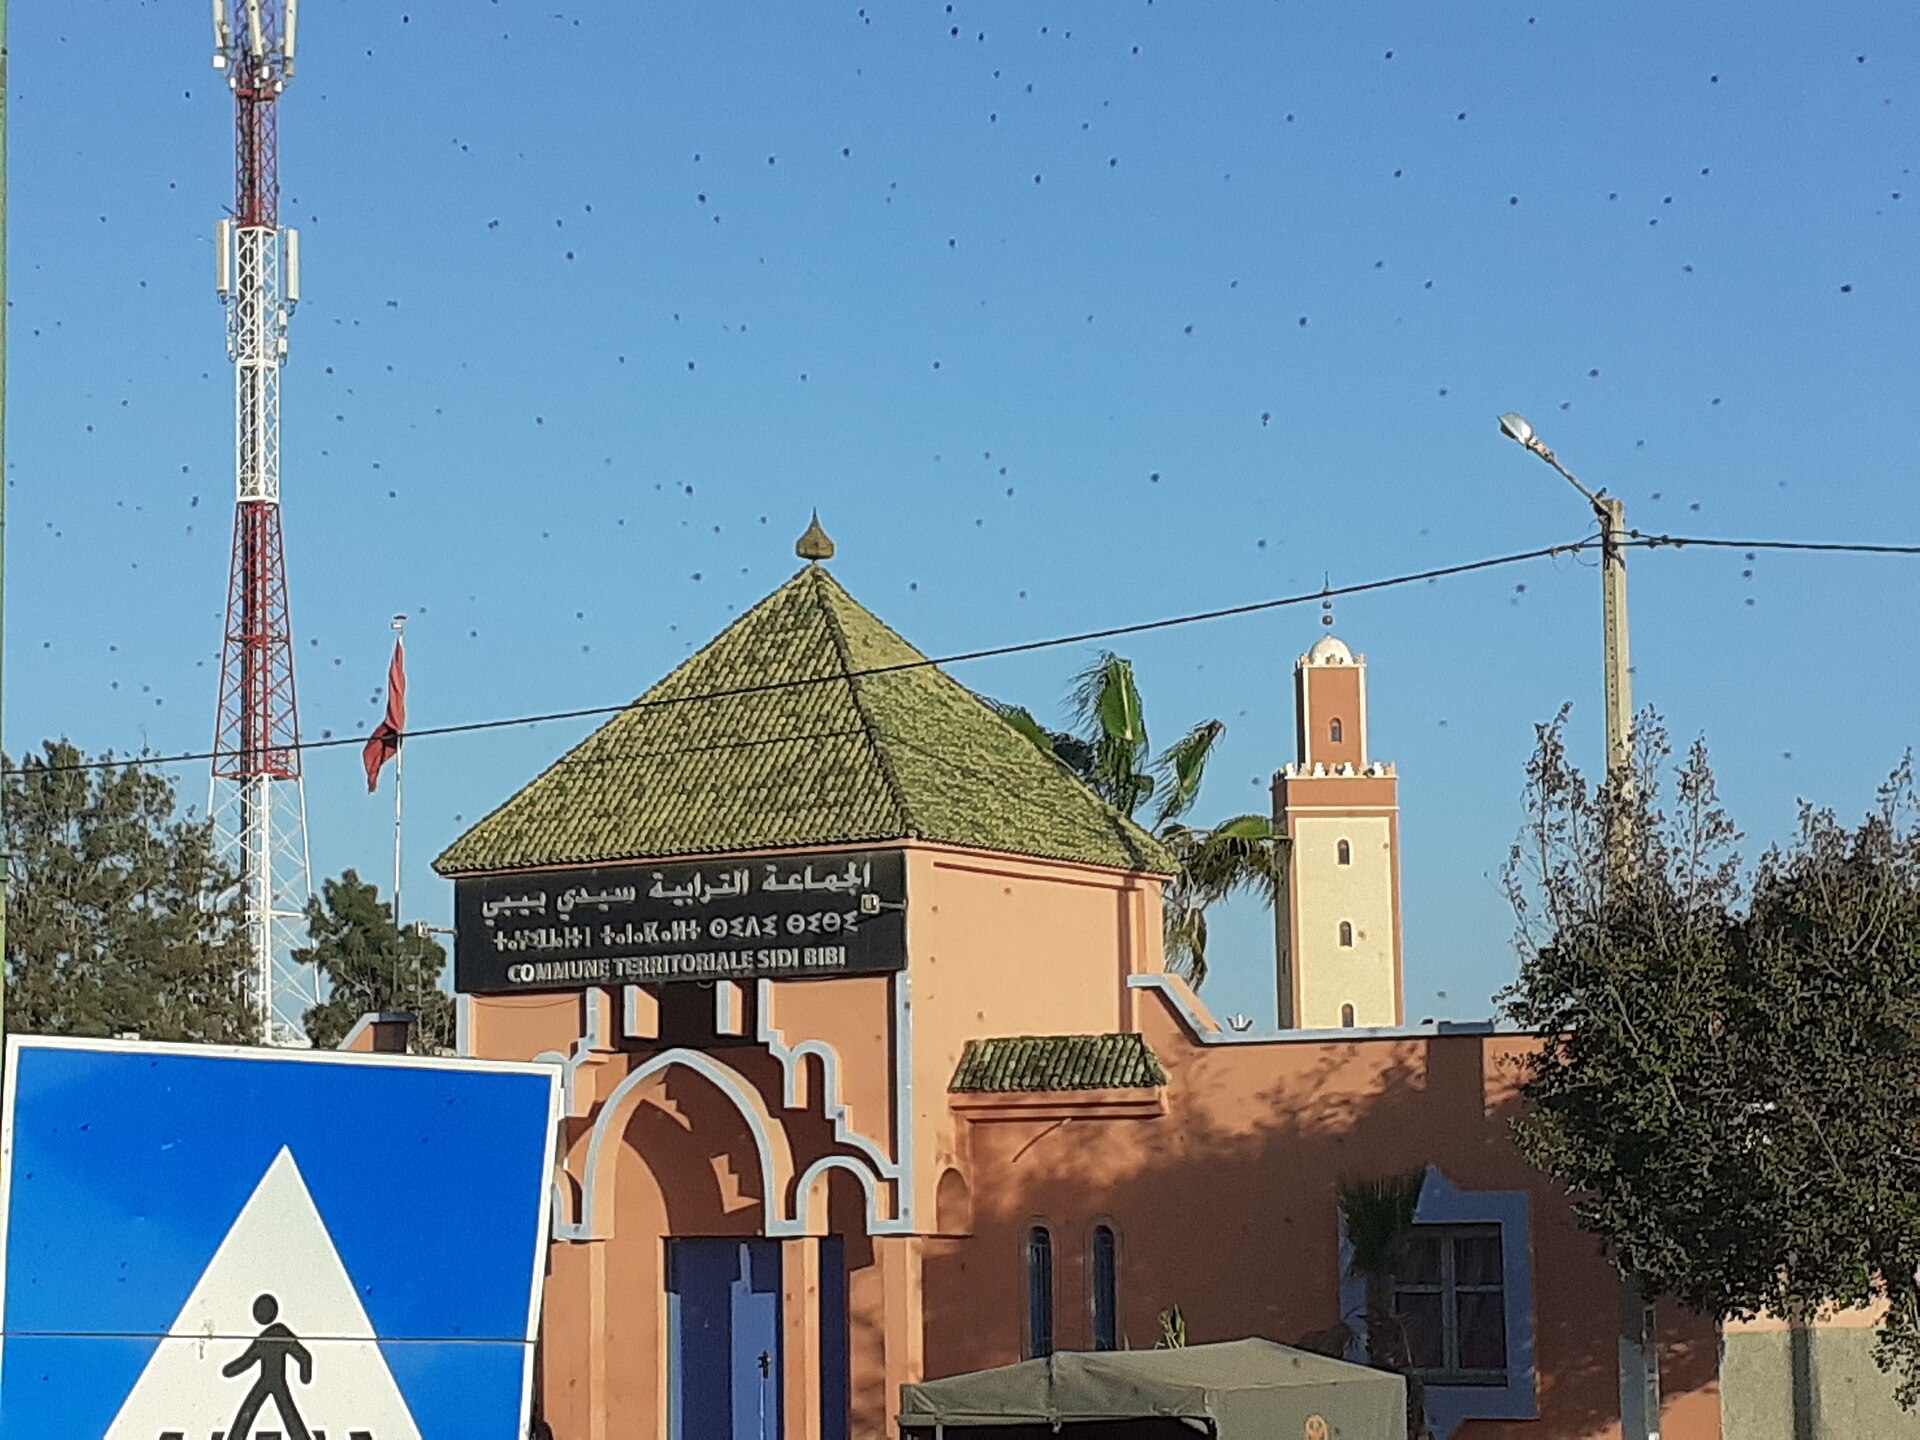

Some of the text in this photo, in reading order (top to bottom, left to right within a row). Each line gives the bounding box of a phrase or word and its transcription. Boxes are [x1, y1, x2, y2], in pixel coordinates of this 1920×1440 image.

[482, 861, 871, 927] الجماعة الترابية سيدي بيبي
[507, 946, 846, 983] COMMUNE TERRITORIALE SIDI BIBI
